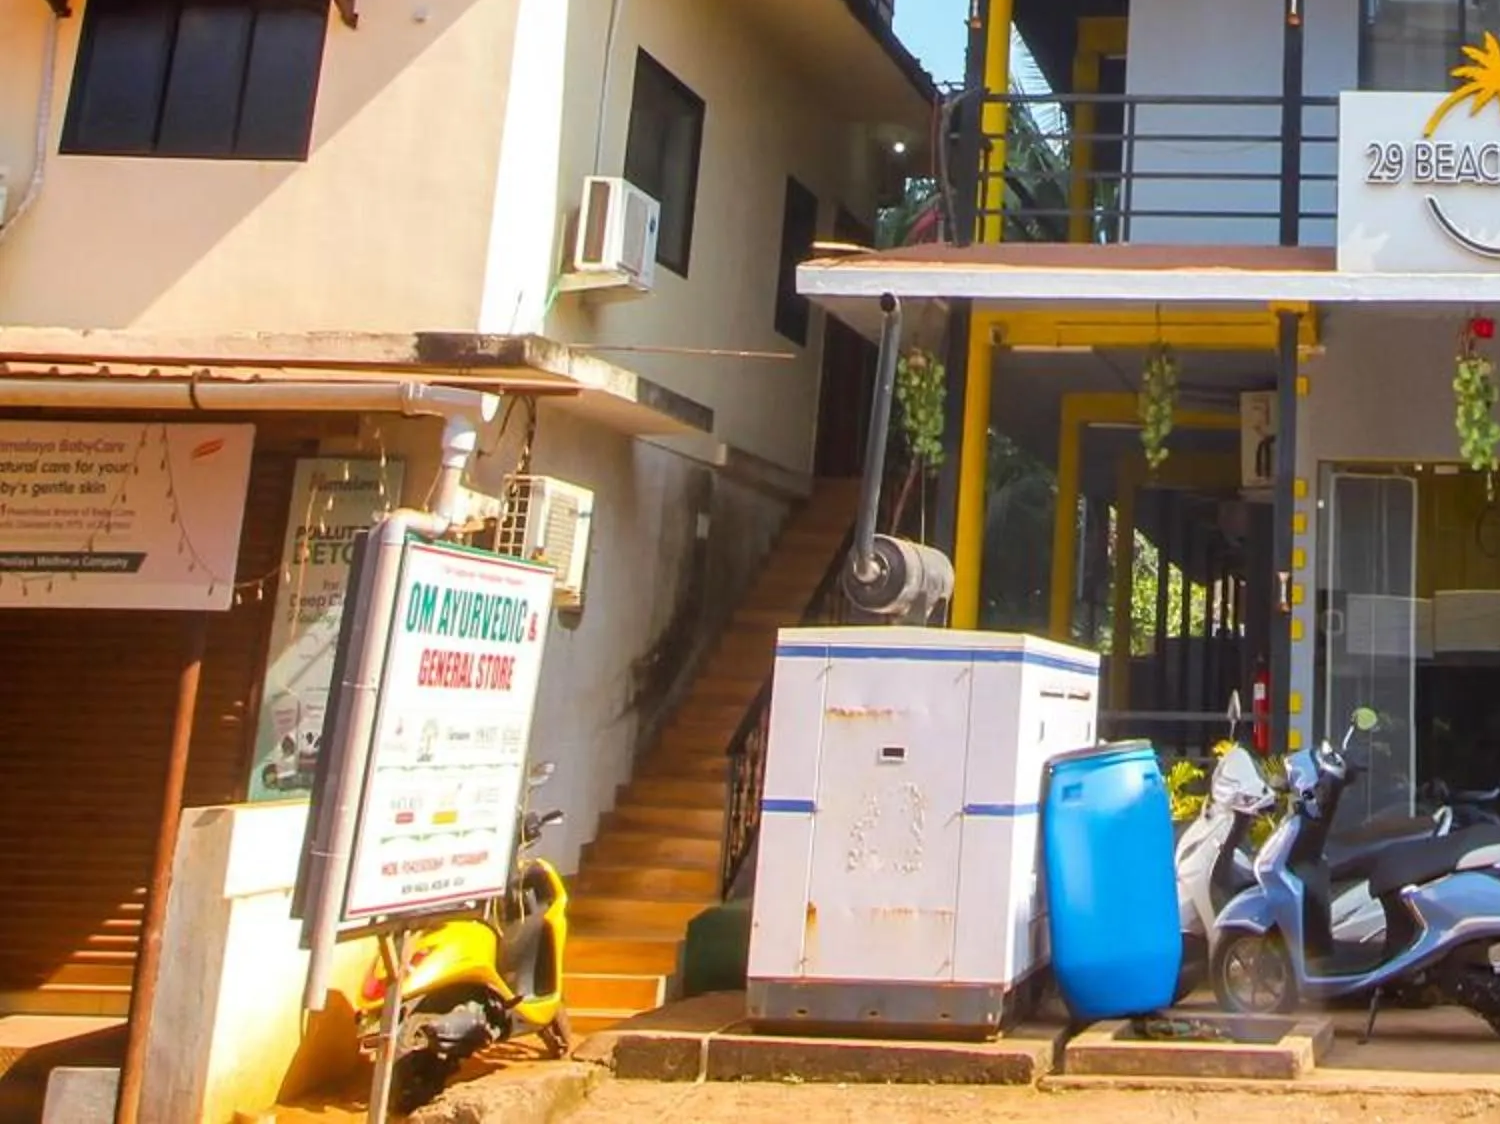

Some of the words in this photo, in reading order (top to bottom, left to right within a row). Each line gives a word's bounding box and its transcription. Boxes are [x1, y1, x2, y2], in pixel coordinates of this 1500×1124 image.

[1364, 141, 1406, 185] 29
[31, 480, 75, 497] gentle
[79, 480, 106, 494] skin
[41, 462, 71, 474] care
[74, 459, 95, 474] for
[97, 462, 131, 477] your
[405, 581, 439, 635] OM
[437, 587, 529, 645] AYURVEDIC
[417, 648, 475, 689] GENERAL
[475, 653, 516, 692] STORE
